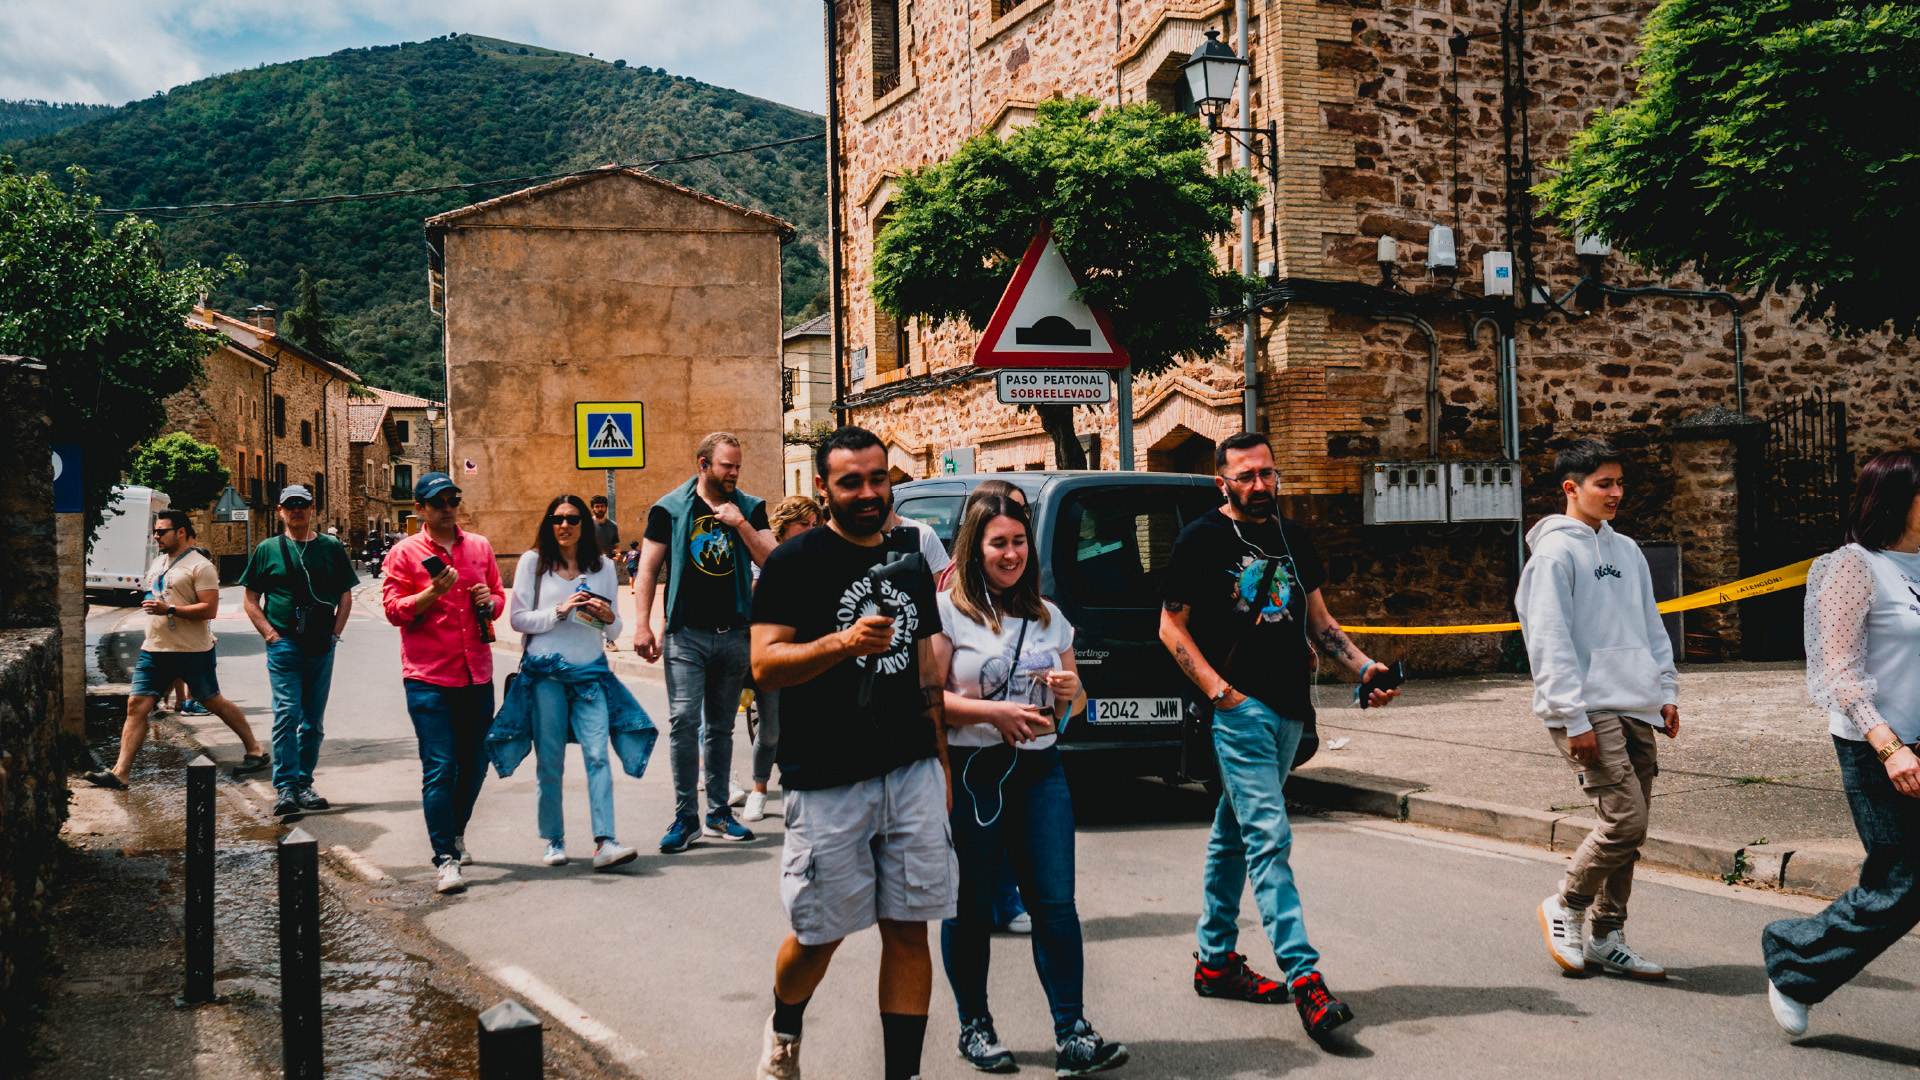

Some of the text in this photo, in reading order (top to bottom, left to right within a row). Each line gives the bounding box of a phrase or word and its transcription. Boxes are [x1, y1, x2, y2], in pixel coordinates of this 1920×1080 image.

[1006, 375, 1103, 385] PASO PEATONAL
[1010, 388, 1101, 398] SOBREELEVADO
[880, 580, 919, 644] SIERRA
[1100, 701, 1139, 719] 2042
[1151, 700, 1178, 718] JMW
